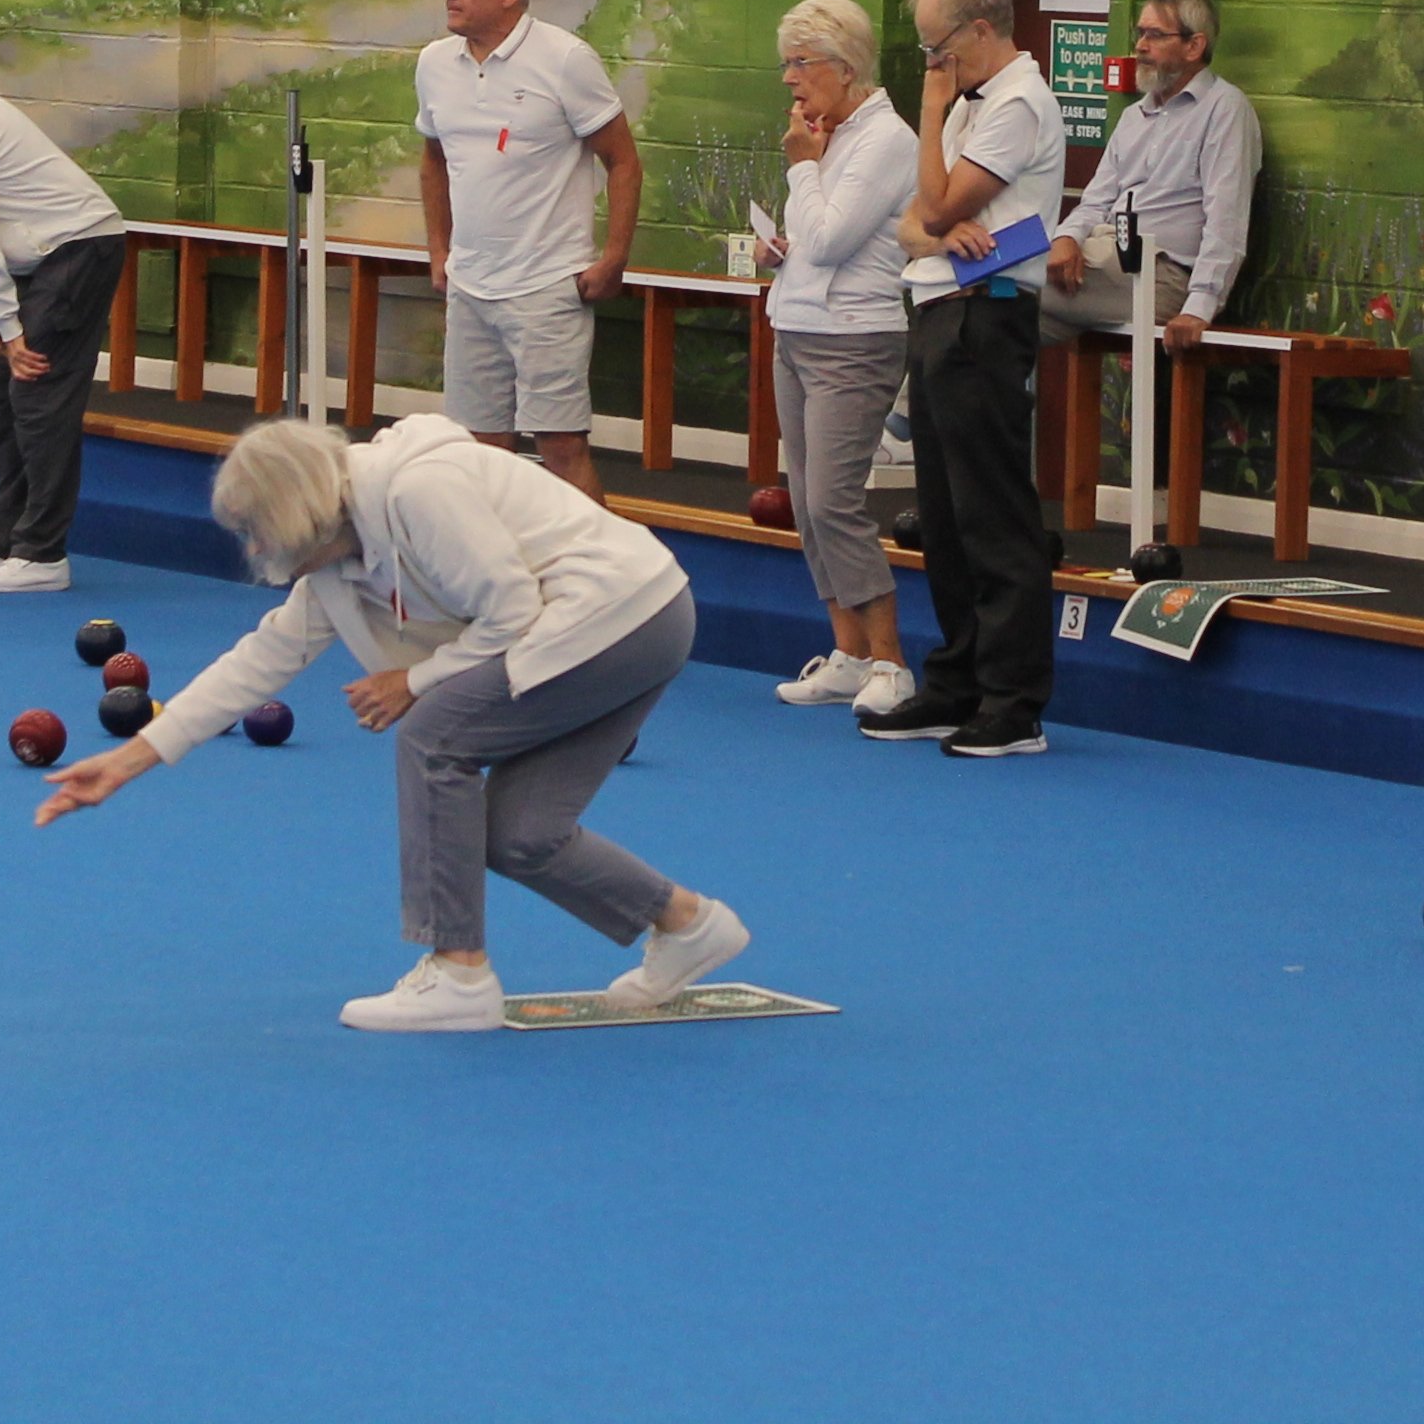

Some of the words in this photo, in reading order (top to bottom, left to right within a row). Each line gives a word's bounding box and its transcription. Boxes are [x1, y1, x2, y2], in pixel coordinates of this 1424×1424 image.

[1057, 27, 1086, 45] Push
[1088, 29, 1107, 46] bar
[1060, 48, 1072, 64] to
[1074, 51, 1102, 68] open
[1062, 106, 1084, 119] EASE
[1086, 107, 1107, 120] MIND
[1064, 124, 1074, 137] HE
[1076, 125, 1101, 139] STEPS
[1068, 605, 1080, 630] 3
